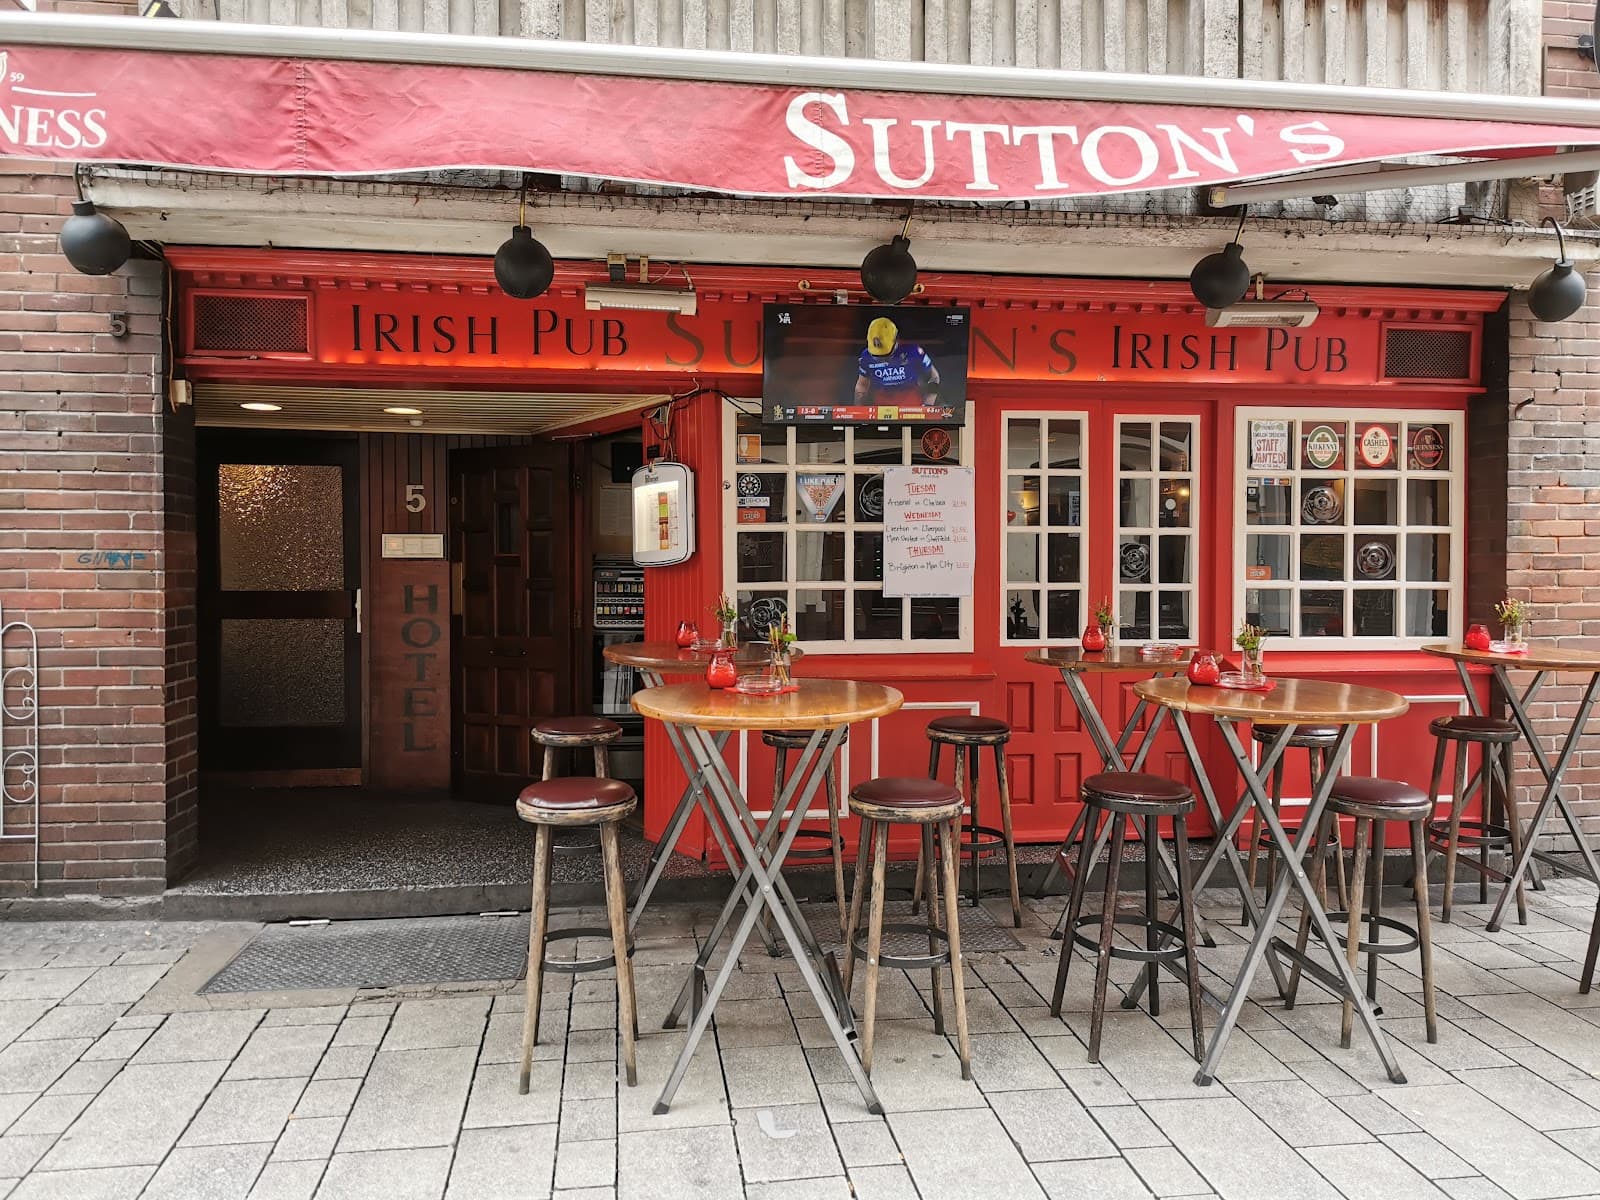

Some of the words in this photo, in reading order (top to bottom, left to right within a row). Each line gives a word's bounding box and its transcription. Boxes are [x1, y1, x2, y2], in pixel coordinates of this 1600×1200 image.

[10, 71, 25, 82] 59
[783, 91, 1345, 191] SUTTON'S
[110, 311, 127, 338] 5
[351, 303, 499, 355] IRISH
[532, 308, 628, 357] PUB
[665, 309, 1077, 375] SUN'S
[1112, 325, 1237, 371] IRISH
[1265, 327, 1348, 373] PUB
[874, 366, 905, 378] QATAR
[1256, 439, 1279, 452] STAFF
[1308, 443, 1338, 451] KILKENNY
[904, 483, 936, 494] TUESDAY
[405, 484, 427, 513] 5
[923, 498, 946, 506] Chelsea
[904, 511, 941, 520] WEDNESDAY
[401, 583, 441, 753] HOTEL
